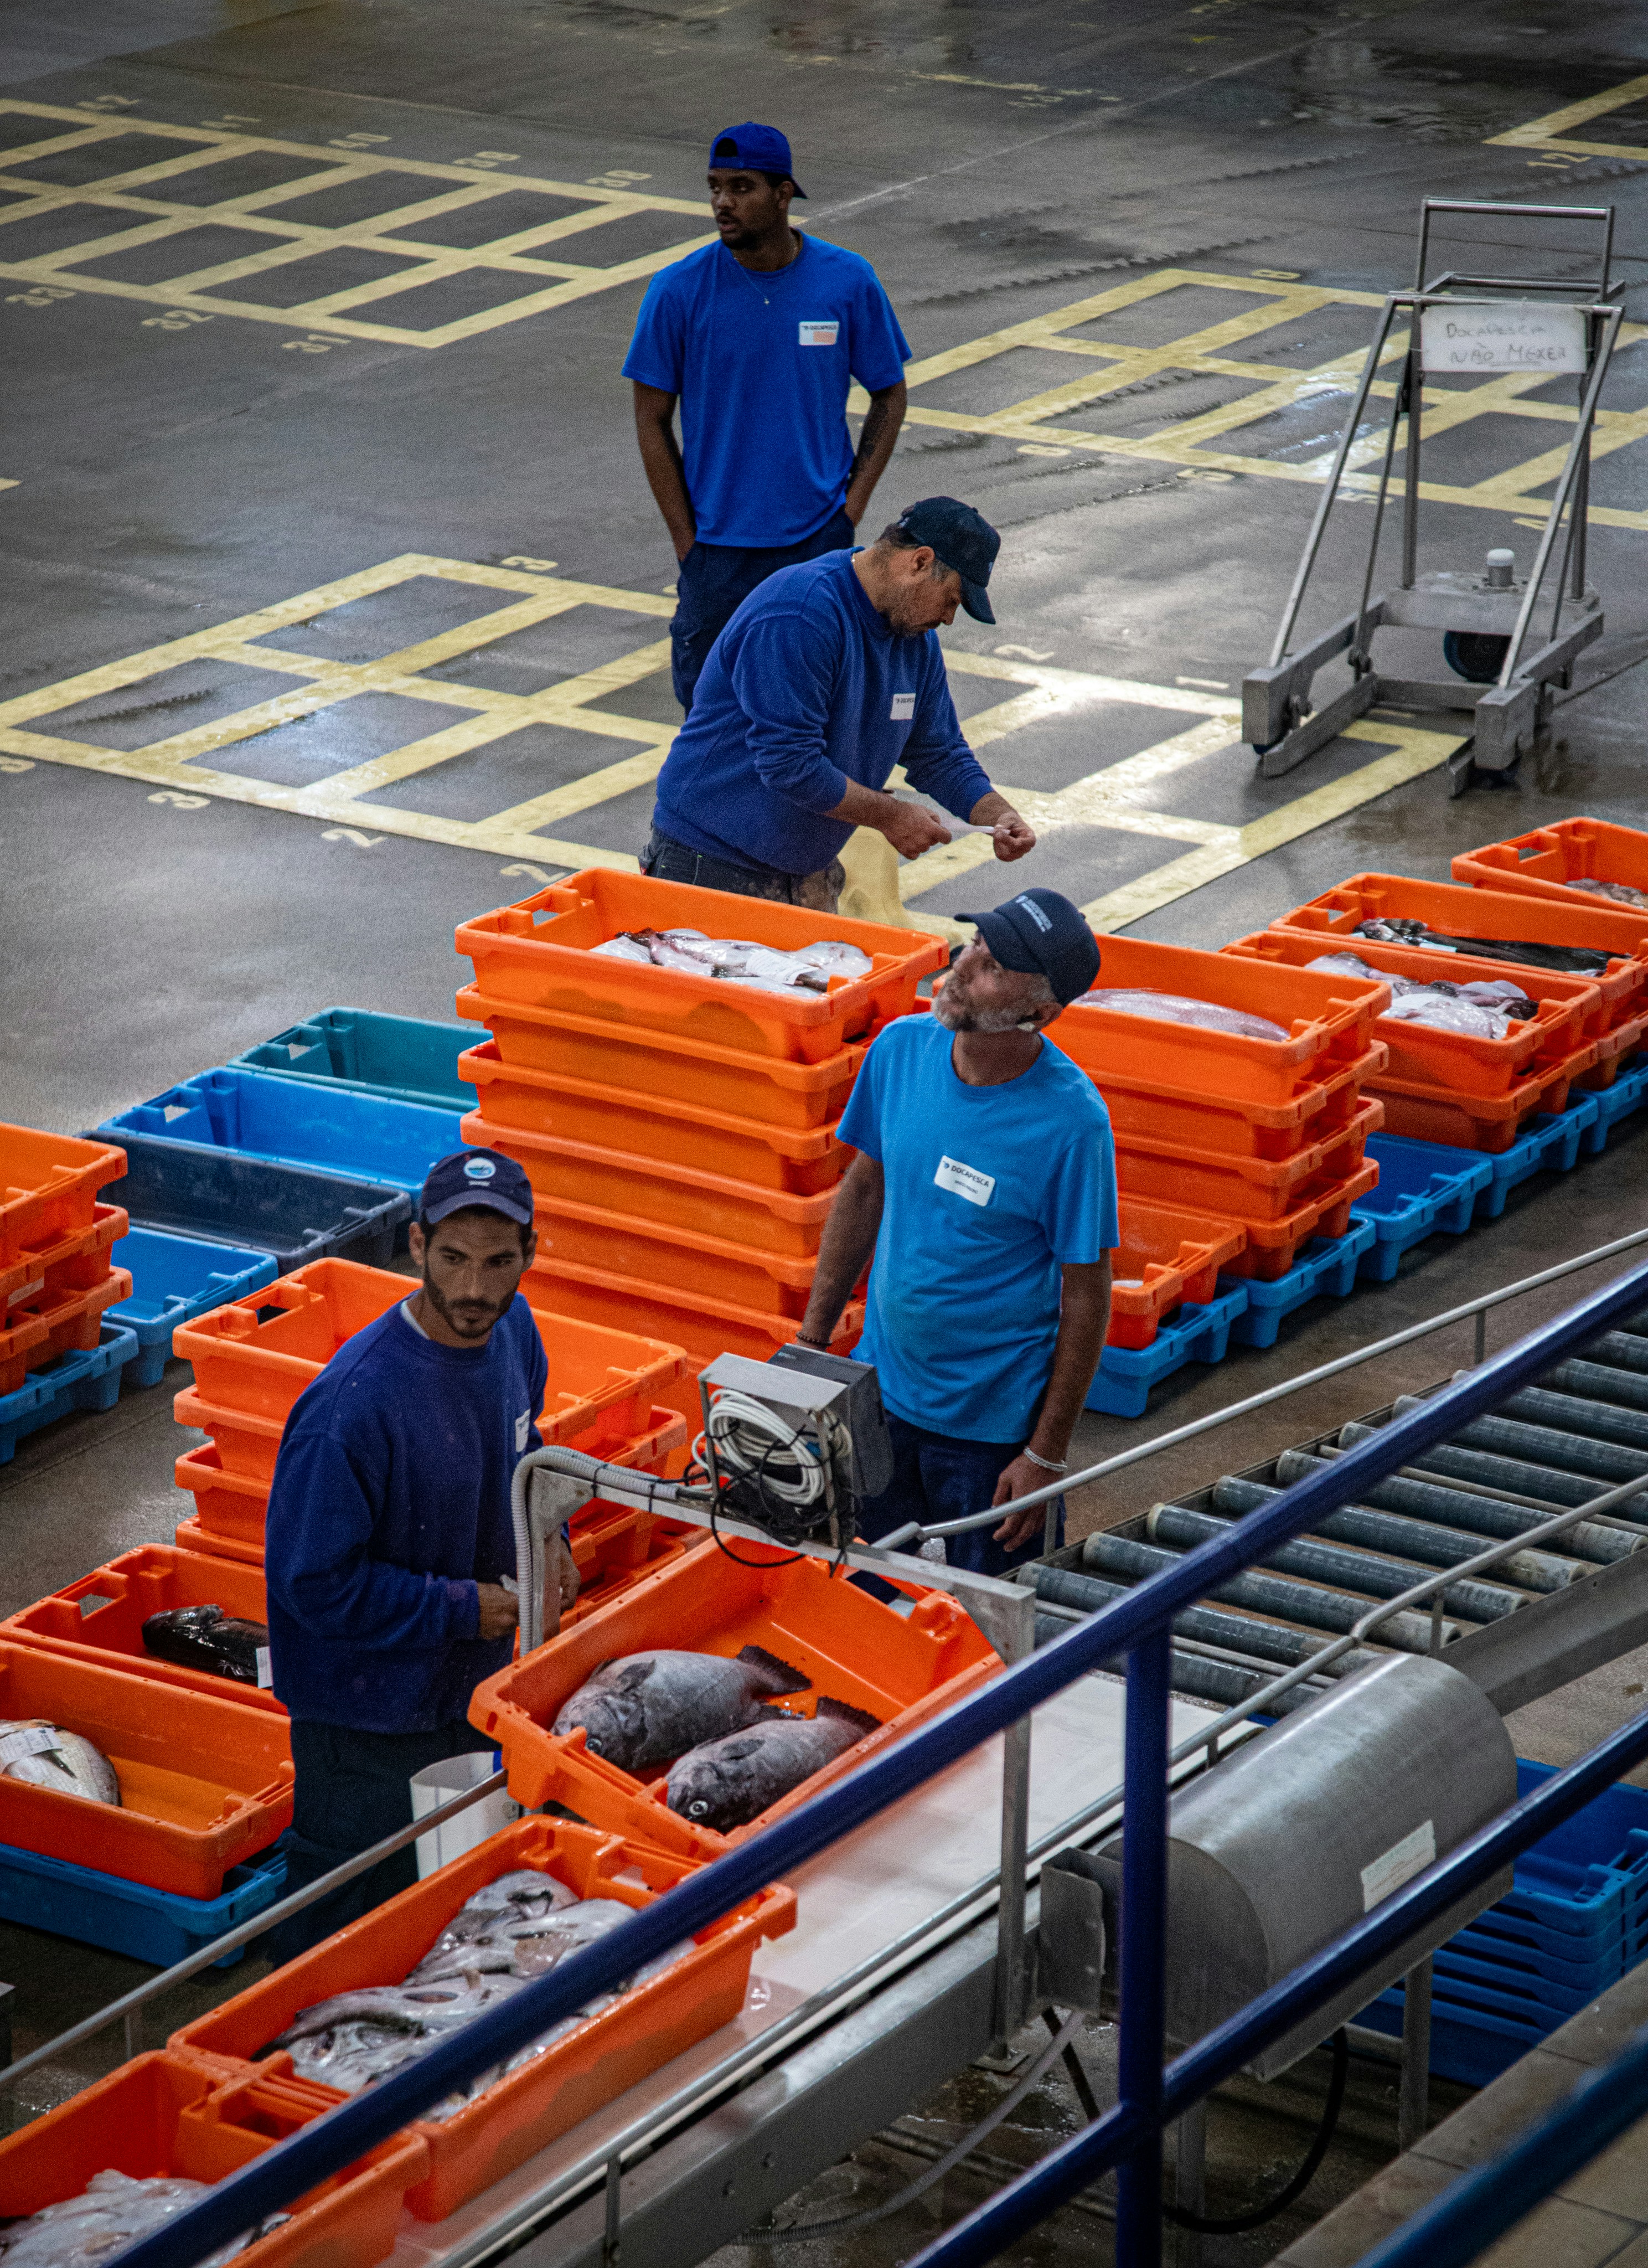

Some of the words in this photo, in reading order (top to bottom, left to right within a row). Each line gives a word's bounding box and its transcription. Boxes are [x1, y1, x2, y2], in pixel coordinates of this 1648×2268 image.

[1526, 153, 1591, 169] 12
[141, 310, 215, 330] 32
[1508, 343, 1567, 361] MEXER
[501, 555, 559, 571] 3
[147, 791, 211, 809] 3
[321, 828, 386, 848] 2
[500, 863, 566, 884] 2
[951, 1165, 989, 1187] DOCAPESCA
